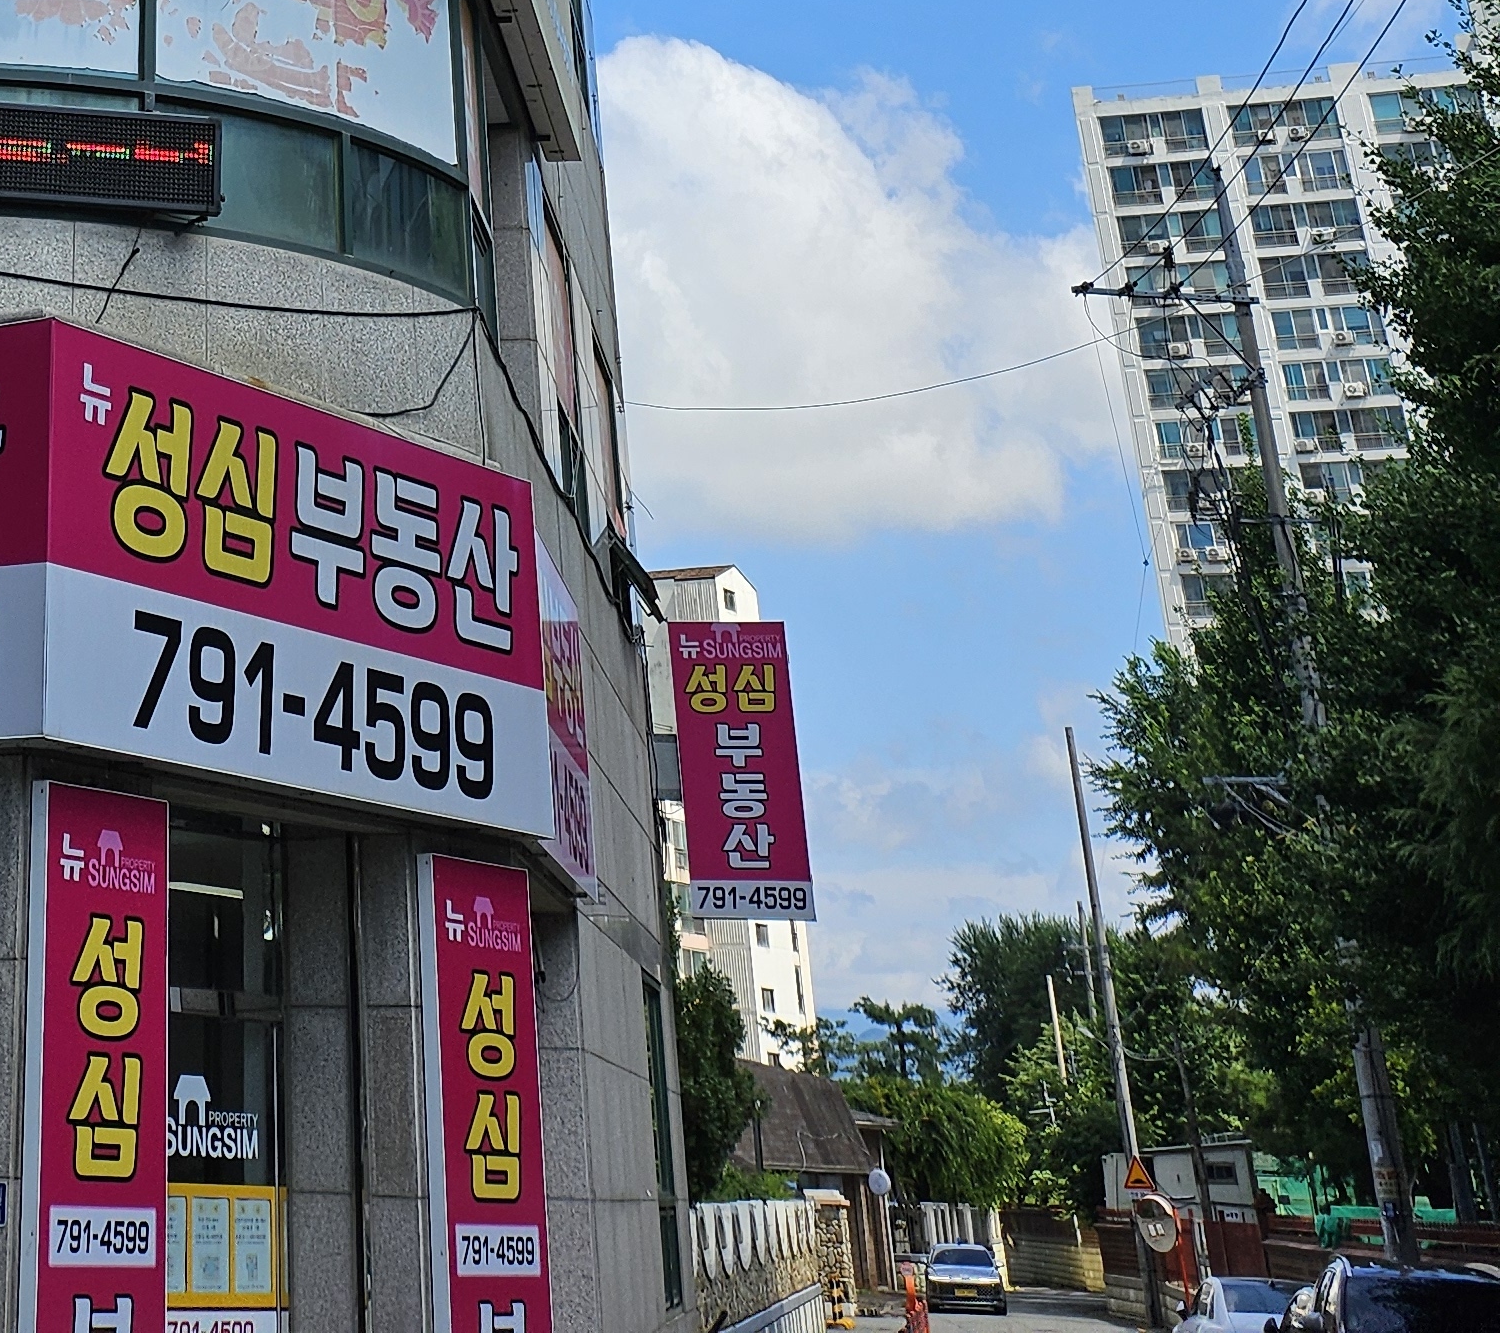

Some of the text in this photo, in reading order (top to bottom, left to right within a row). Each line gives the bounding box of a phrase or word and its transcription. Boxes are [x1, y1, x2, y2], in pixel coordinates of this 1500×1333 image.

[78, 362, 521, 653] 뉴 성심 부동산
[679, 634, 701, 659] 뉴
[703, 639, 782, 659] SUNGSIM
[132, 609, 495, 802] 791-4599
[684, 664, 776, 713] 성심
[715, 723, 775, 869] 부동산
[59, 832, 85, 883] 뉴
[120, 856, 156, 871] PROPERTY
[87, 864, 156, 895] SUNGSIM
[697, 885, 808, 911] 791-4599
[444, 899, 466, 942] 뉴
[467, 921, 522, 953] SUNGSIM
[68, 915, 144, 1179] 성심
[460, 972, 520, 1200] 성심
[208, 1111, 259, 1128] PROPERTY
[55, 1219, 151, 1256] 791-4599
[460, 1231, 536, 1268] 791-4599
